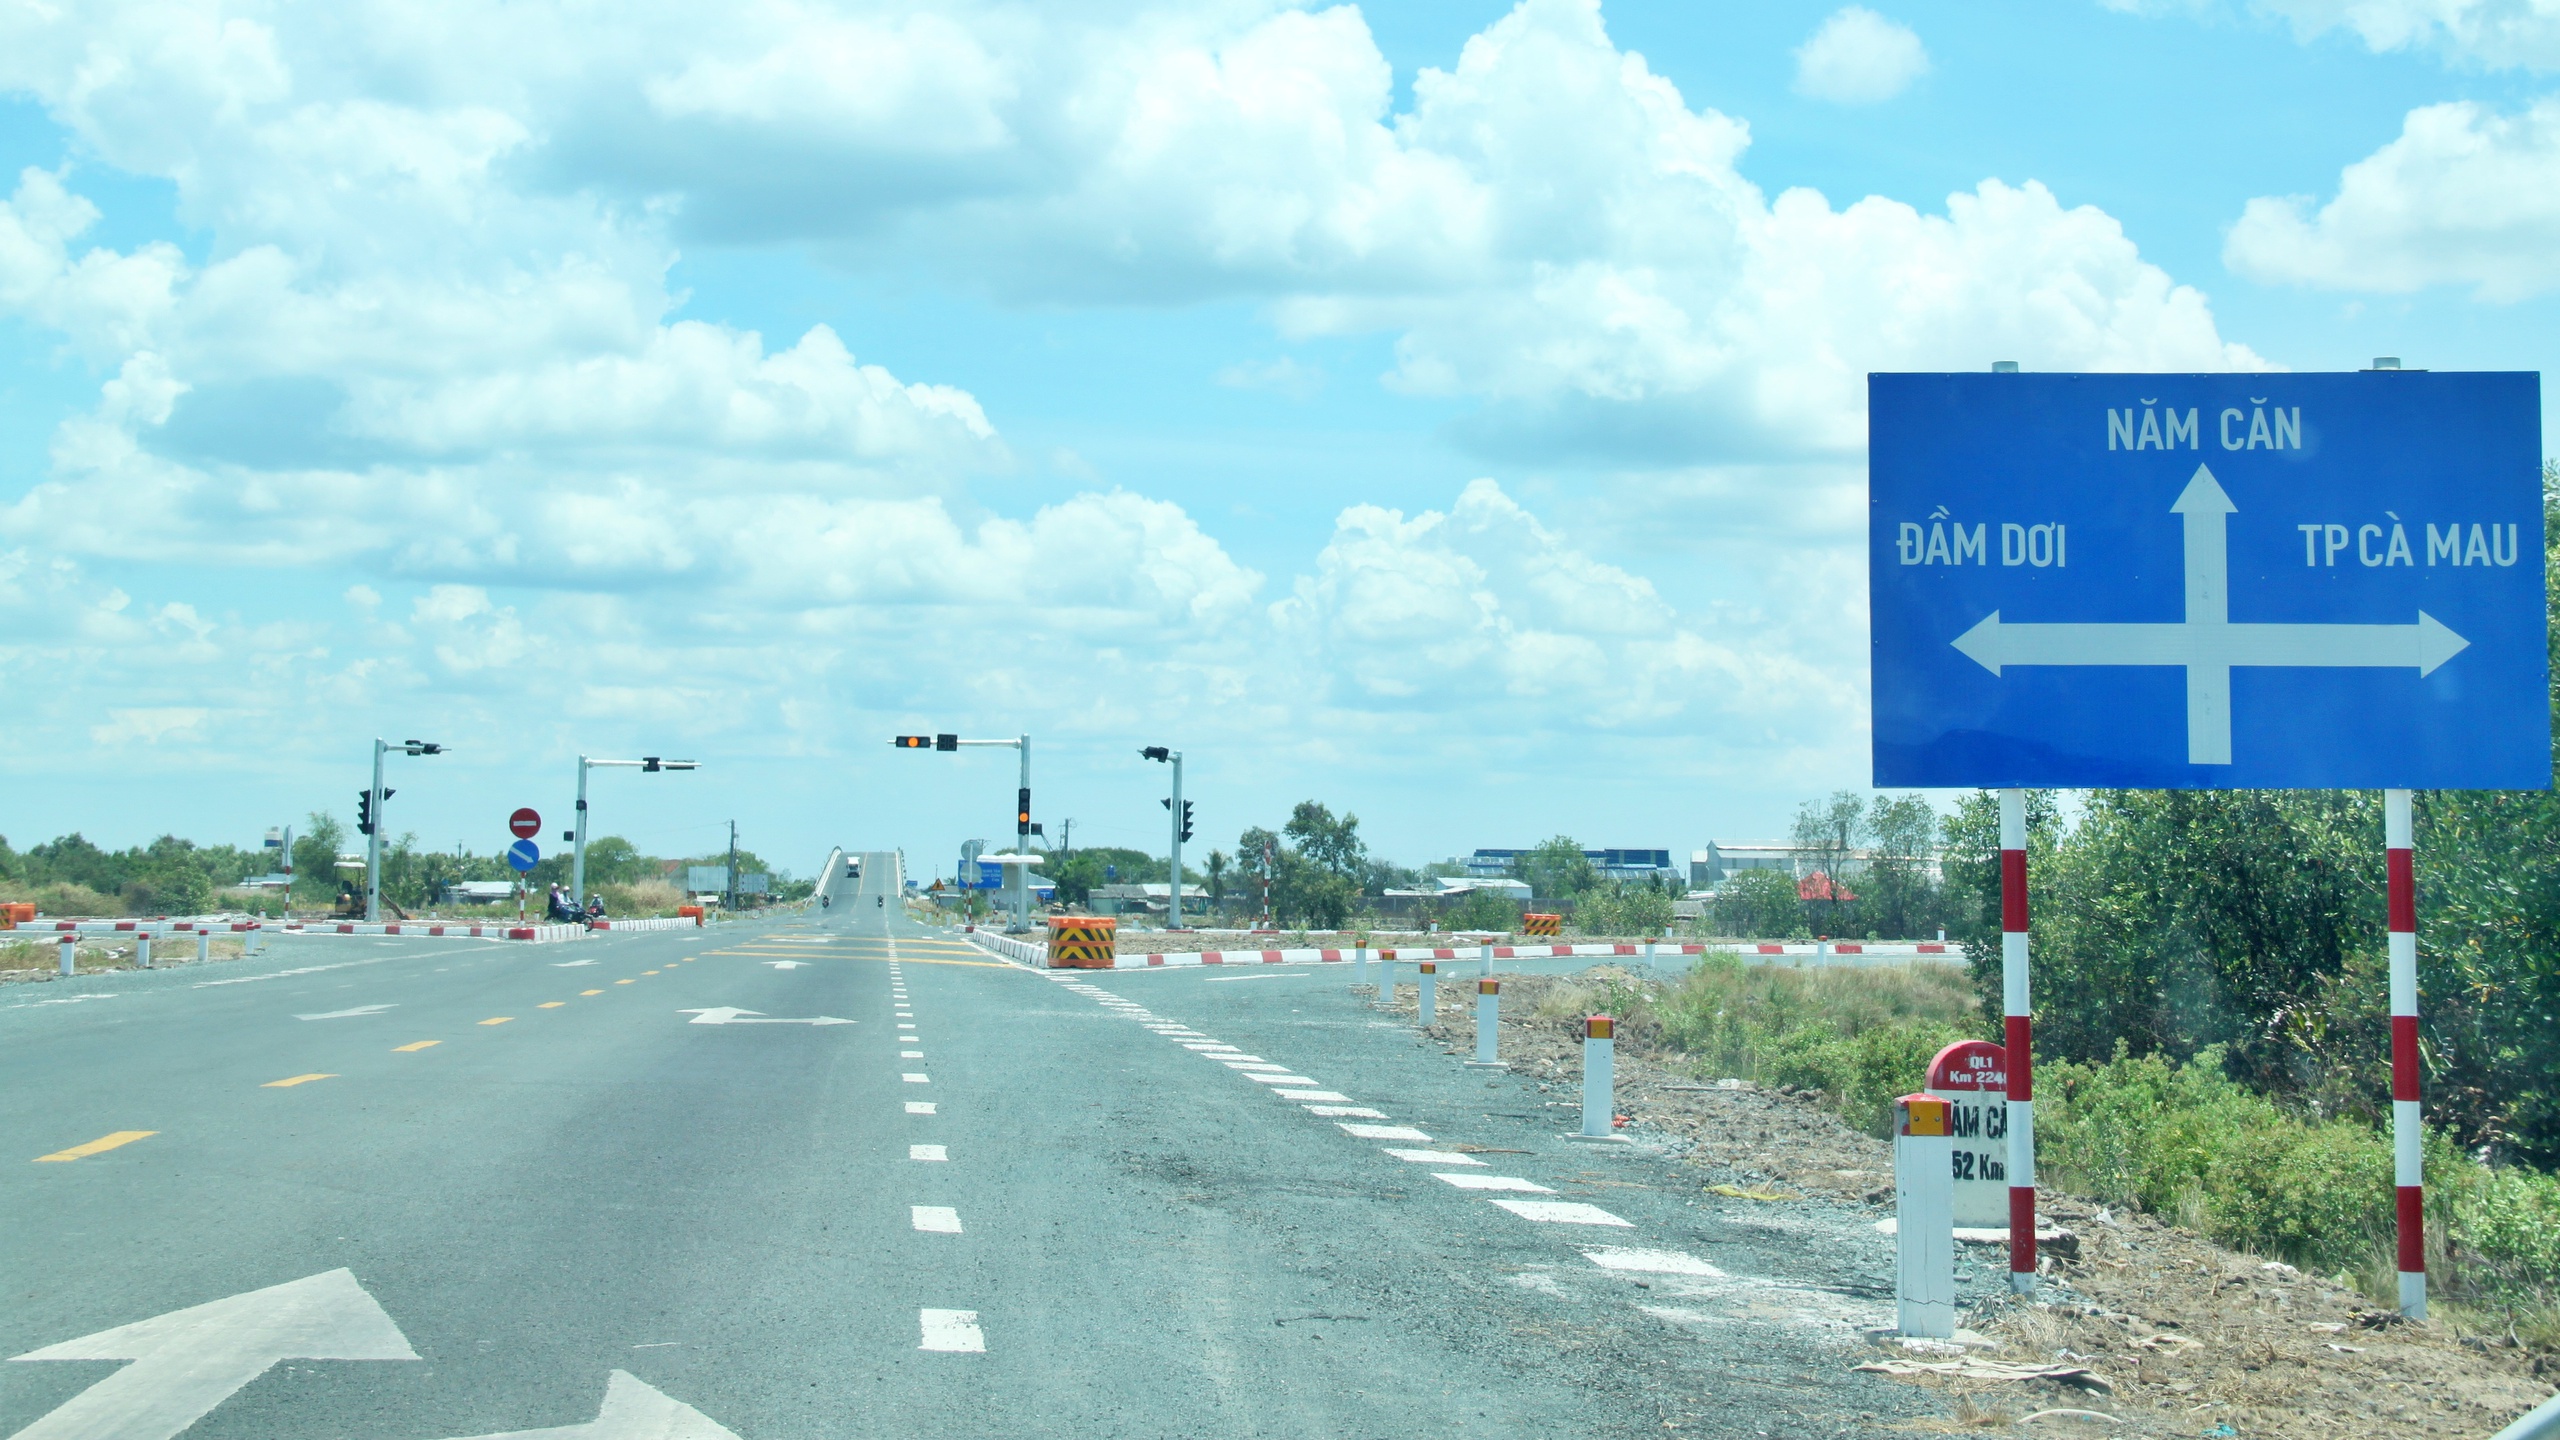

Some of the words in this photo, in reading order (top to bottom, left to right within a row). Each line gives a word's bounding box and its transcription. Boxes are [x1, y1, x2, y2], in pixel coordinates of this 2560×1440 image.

[2107, 397, 2199, 451] NĂM
[2220, 397, 2302, 451] CĂN
[1895, 505, 1986, 566] ĐẦM
[2001, 521, 2066, 568] DƠI
[2297, 523, 2349, 567] TP
[2358, 511, 2414, 568] CÀ
[2426, 523, 2518, 567] MAU
[1949, 1070, 1972, 1084] Km
[1976, 1071, 2007, 1085] 224
[1969, 1056, 1993, 1069] QL1
[1952, 1099, 1980, 1138] ĂM
[1986, 1100, 2008, 1139] CĂ
[1952, 1150, 1975, 1180] 52
[1980, 1153, 2005, 1181] Km
